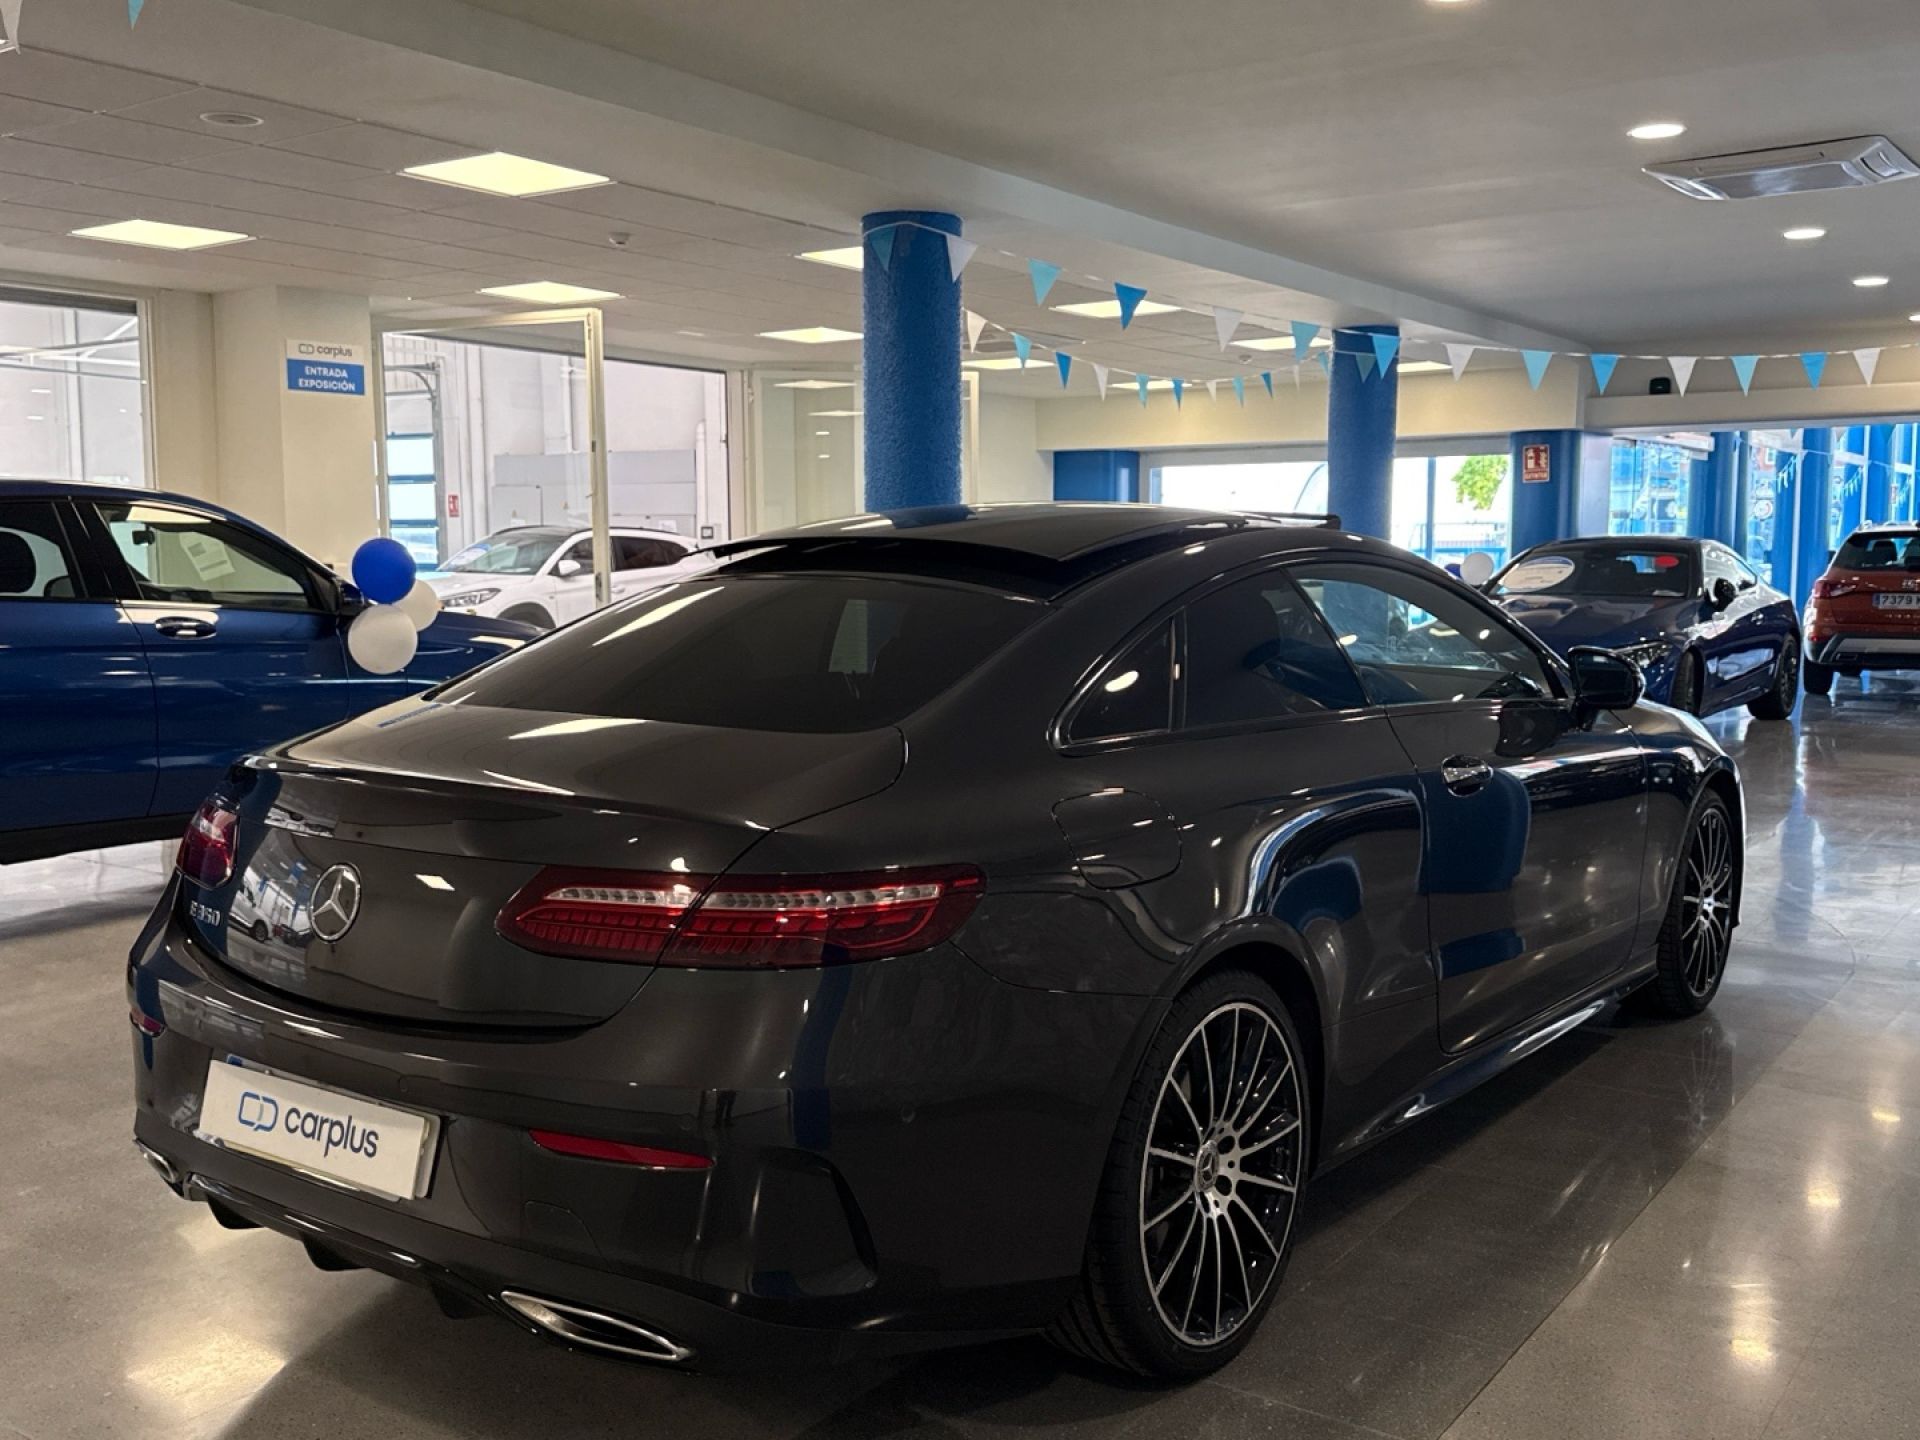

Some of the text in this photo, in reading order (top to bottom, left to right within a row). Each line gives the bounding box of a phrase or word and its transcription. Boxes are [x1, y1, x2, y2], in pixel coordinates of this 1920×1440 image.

[317, 345, 353, 358] carplus
[304, 365, 349, 379] ENTRADA
[298, 378, 356, 392] EXPOSICIÓN
[284, 1107, 380, 1158] carplus
